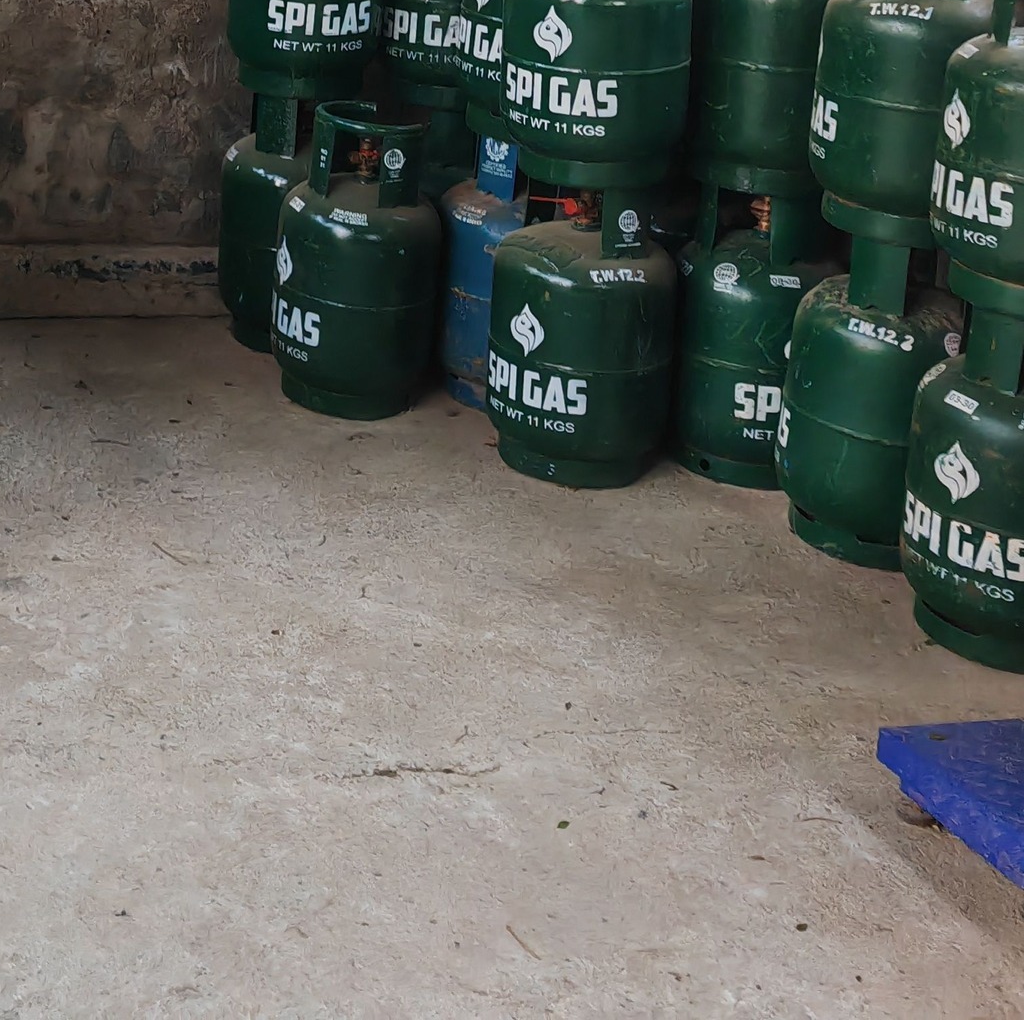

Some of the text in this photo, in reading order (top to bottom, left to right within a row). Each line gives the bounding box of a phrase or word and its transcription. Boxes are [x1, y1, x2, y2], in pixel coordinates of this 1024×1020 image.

[321, 0, 372, 36] GAS
[382, 5, 418, 44] SPI
[273, 38, 363, 53] NET WT 11 KGS
[386, 46, 404, 58] NET
[406, 50, 424, 61] WT
[429, 54, 439, 64] 11
[474, 24, 502, 64] GA
[476, 67, 484, 78] 11
[506, 62, 618, 118] SPI GAS
[510, 108, 606, 137] NET WT 11 KGS
[946, 168, 1014, 228] GAS
[948, 226, 960, 240] 11
[963, 229, 998, 249] KGS
[590, 268, 647, 284] T.W.12.2
[278, 300, 321, 348] GAS
[848, 318, 914, 352] T.W.12.2
[286, 345, 309, 362] KGS
[488, 350, 588, 416] SPI GAS
[490, 396, 575, 434] NET WT 11 KGS
[742, 428, 775, 441] NET
[904, 490, 1024, 582] SPI GAS
[975, 580, 1016, 603] KGS
